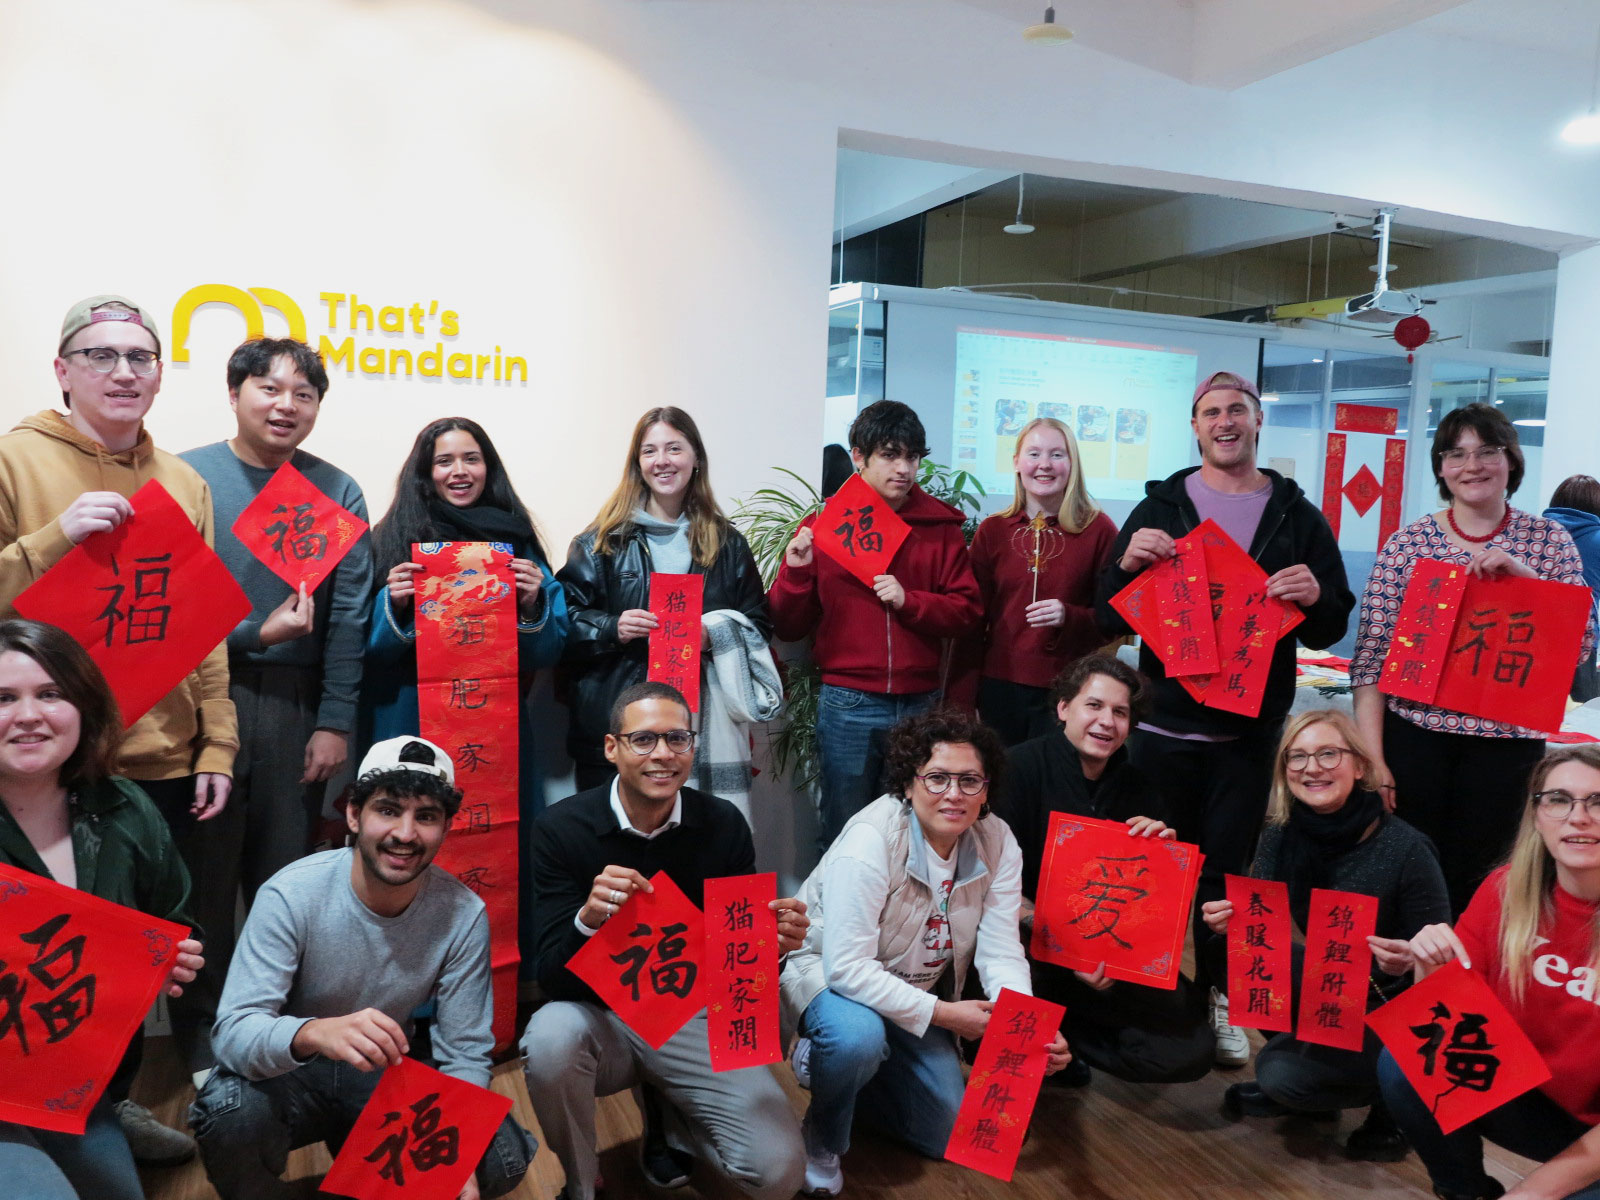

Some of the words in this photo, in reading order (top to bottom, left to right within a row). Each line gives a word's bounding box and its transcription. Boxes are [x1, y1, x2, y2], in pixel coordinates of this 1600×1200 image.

[320, 291, 460, 336] That's
[319, 335, 528, 382] Mandarin
[261, 502, 328, 566] 福
[833, 505, 884, 557] 福
[92, 552, 173, 648] 福
[1453, 608, 1535, 688] 福
[609, 922, 698, 1002] 福
[1244, 891, 1276, 1017] 春暖花開
[1314, 904, 1355, 1030] 錦鯉附體
[1408, 1001, 1500, 1093] 福
[363, 1092, 460, 1187] 福
